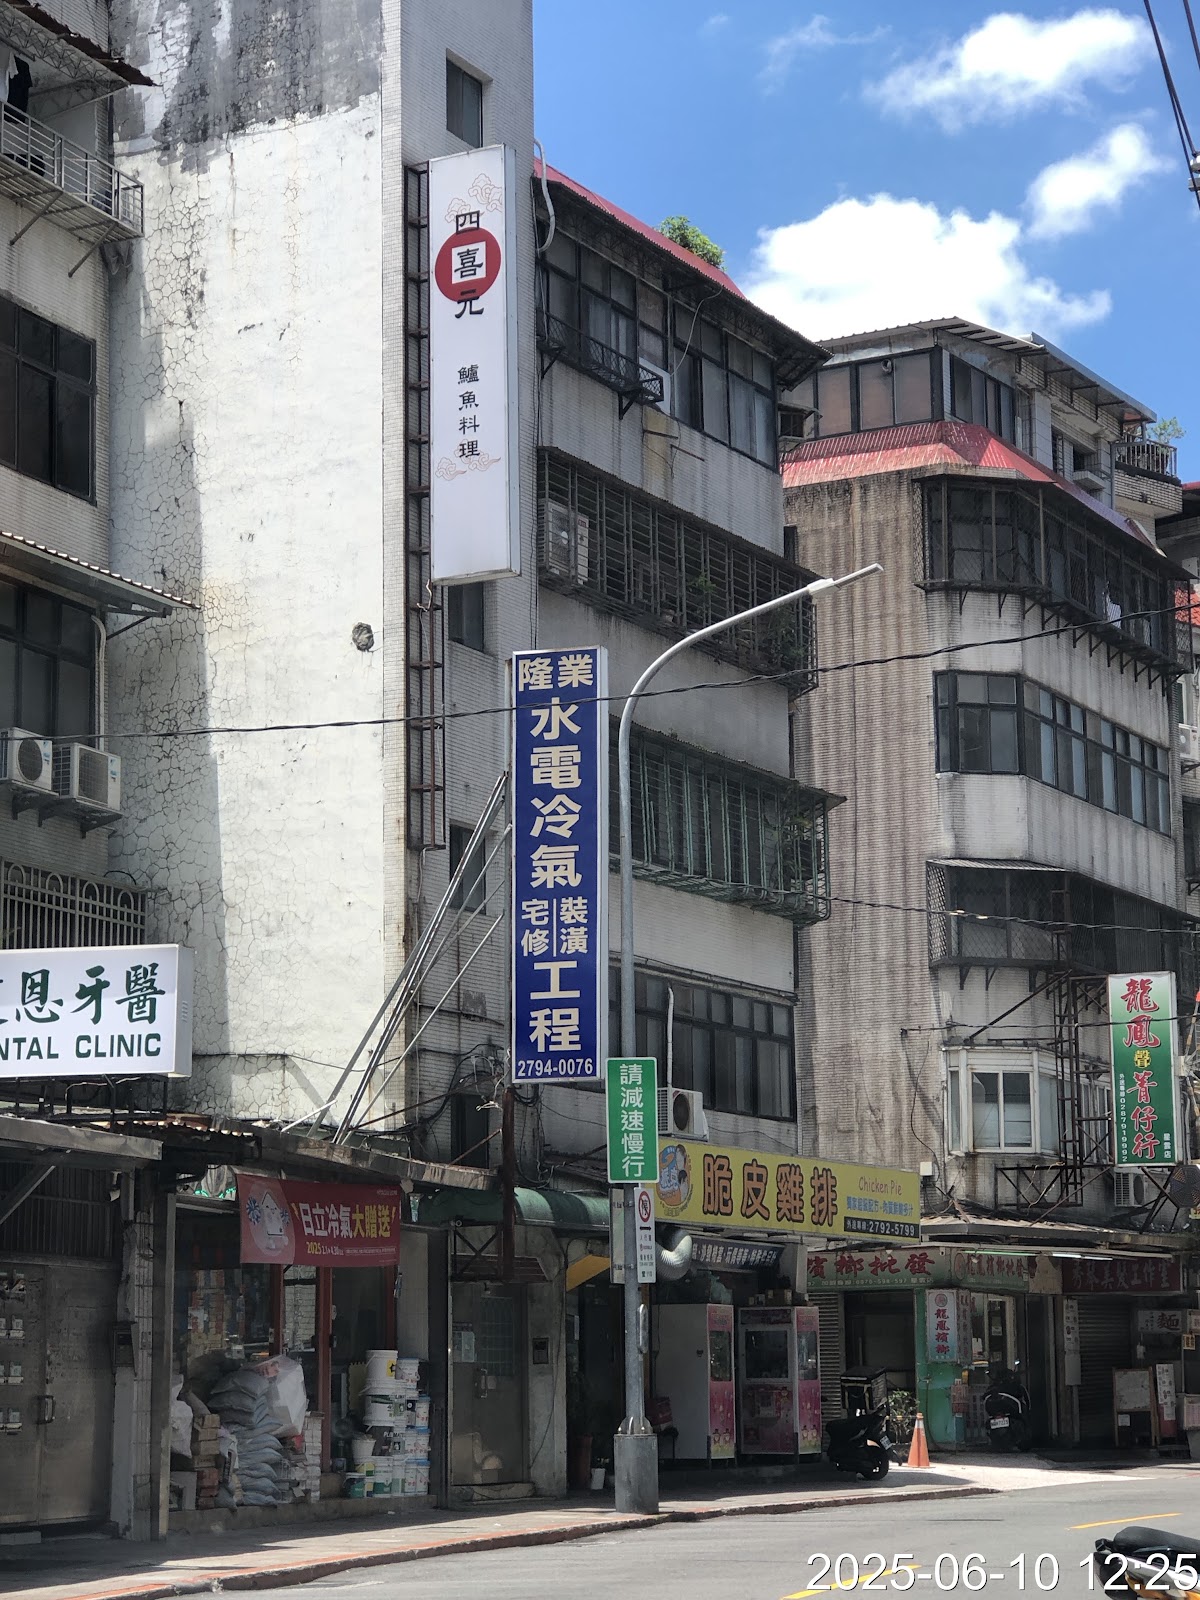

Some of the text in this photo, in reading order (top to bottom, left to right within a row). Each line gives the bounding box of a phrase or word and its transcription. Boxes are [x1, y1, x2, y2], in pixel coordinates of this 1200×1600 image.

[454, 210, 484, 319] 四喜元
[457, 364, 481, 459] 鱸魚料理
[518, 655, 594, 692] 隆業
[530, 697, 582, 889] 水電冷氣
[0, 962, 166, 1026] 恩牙醫
[529, 960, 582, 1053] 工程
[75, 1033, 161, 1059] CLINIC
[518, 1058, 593, 1078] 2794-0076
[620, 1063, 645, 1178] 請減速慢行
[702, 1153, 838, 1227] 脆皮雞排
[858, 1176, 902, 1195] Chicken Pie
[299, 1202, 391, 1239] 日立冷氣大贈送
[307, 1241, 322, 1255] 2025
[1157, 1312, 1180, 1331] 麵
